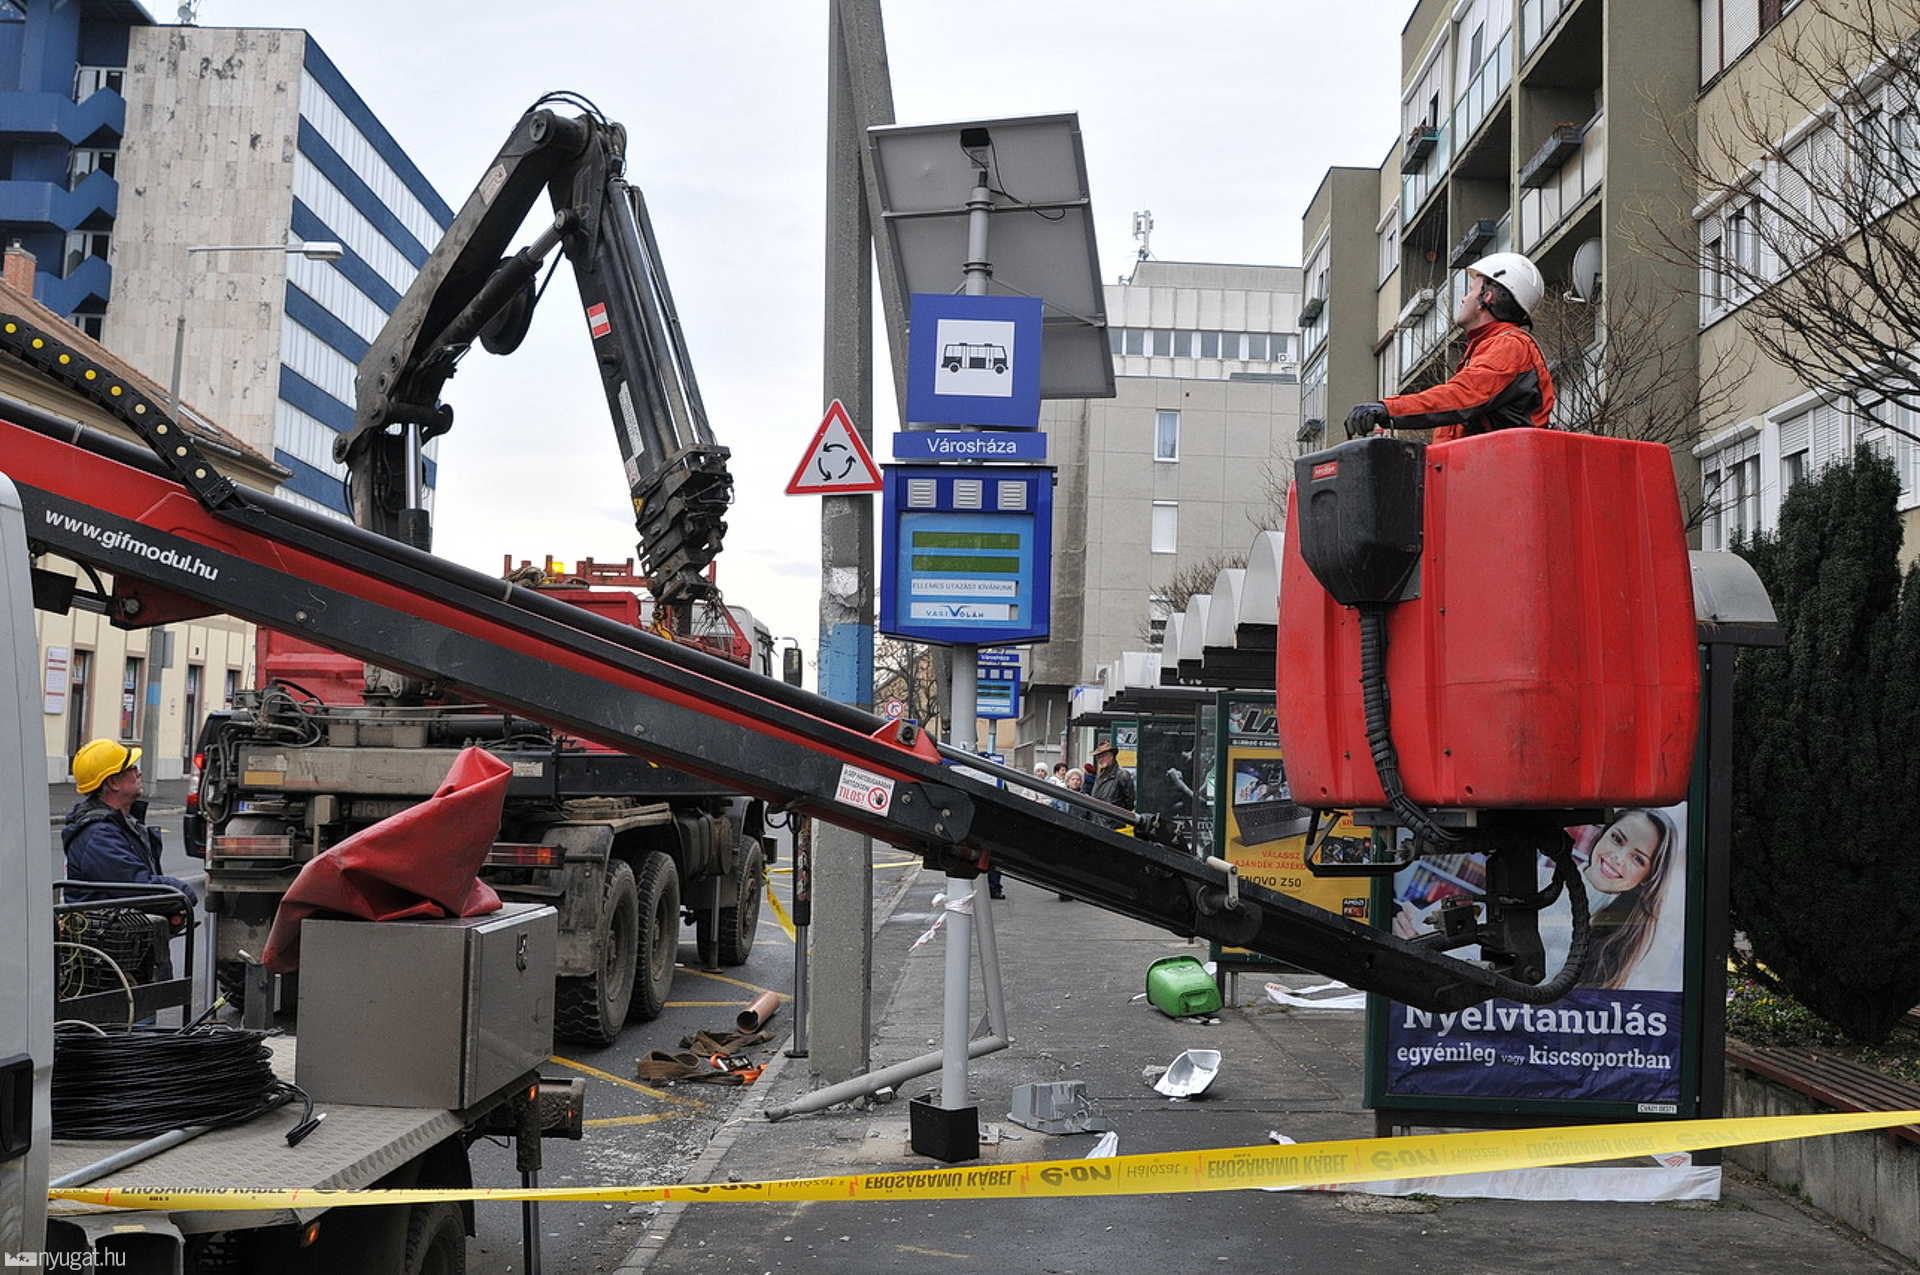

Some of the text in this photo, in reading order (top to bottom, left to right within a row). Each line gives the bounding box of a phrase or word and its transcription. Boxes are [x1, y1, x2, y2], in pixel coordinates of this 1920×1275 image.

[926, 436, 1017, 455] Városháza
[45, 507, 219, 582] www.gifmodul.hu
[839, 785, 866, 805] TILOS!
[1280, 877, 1302, 888] Z50
[1403, 999, 1668, 1037] Nyelvtanulás
[1397, 1042, 1672, 1071] egyénileg vagy kiscsoportban
